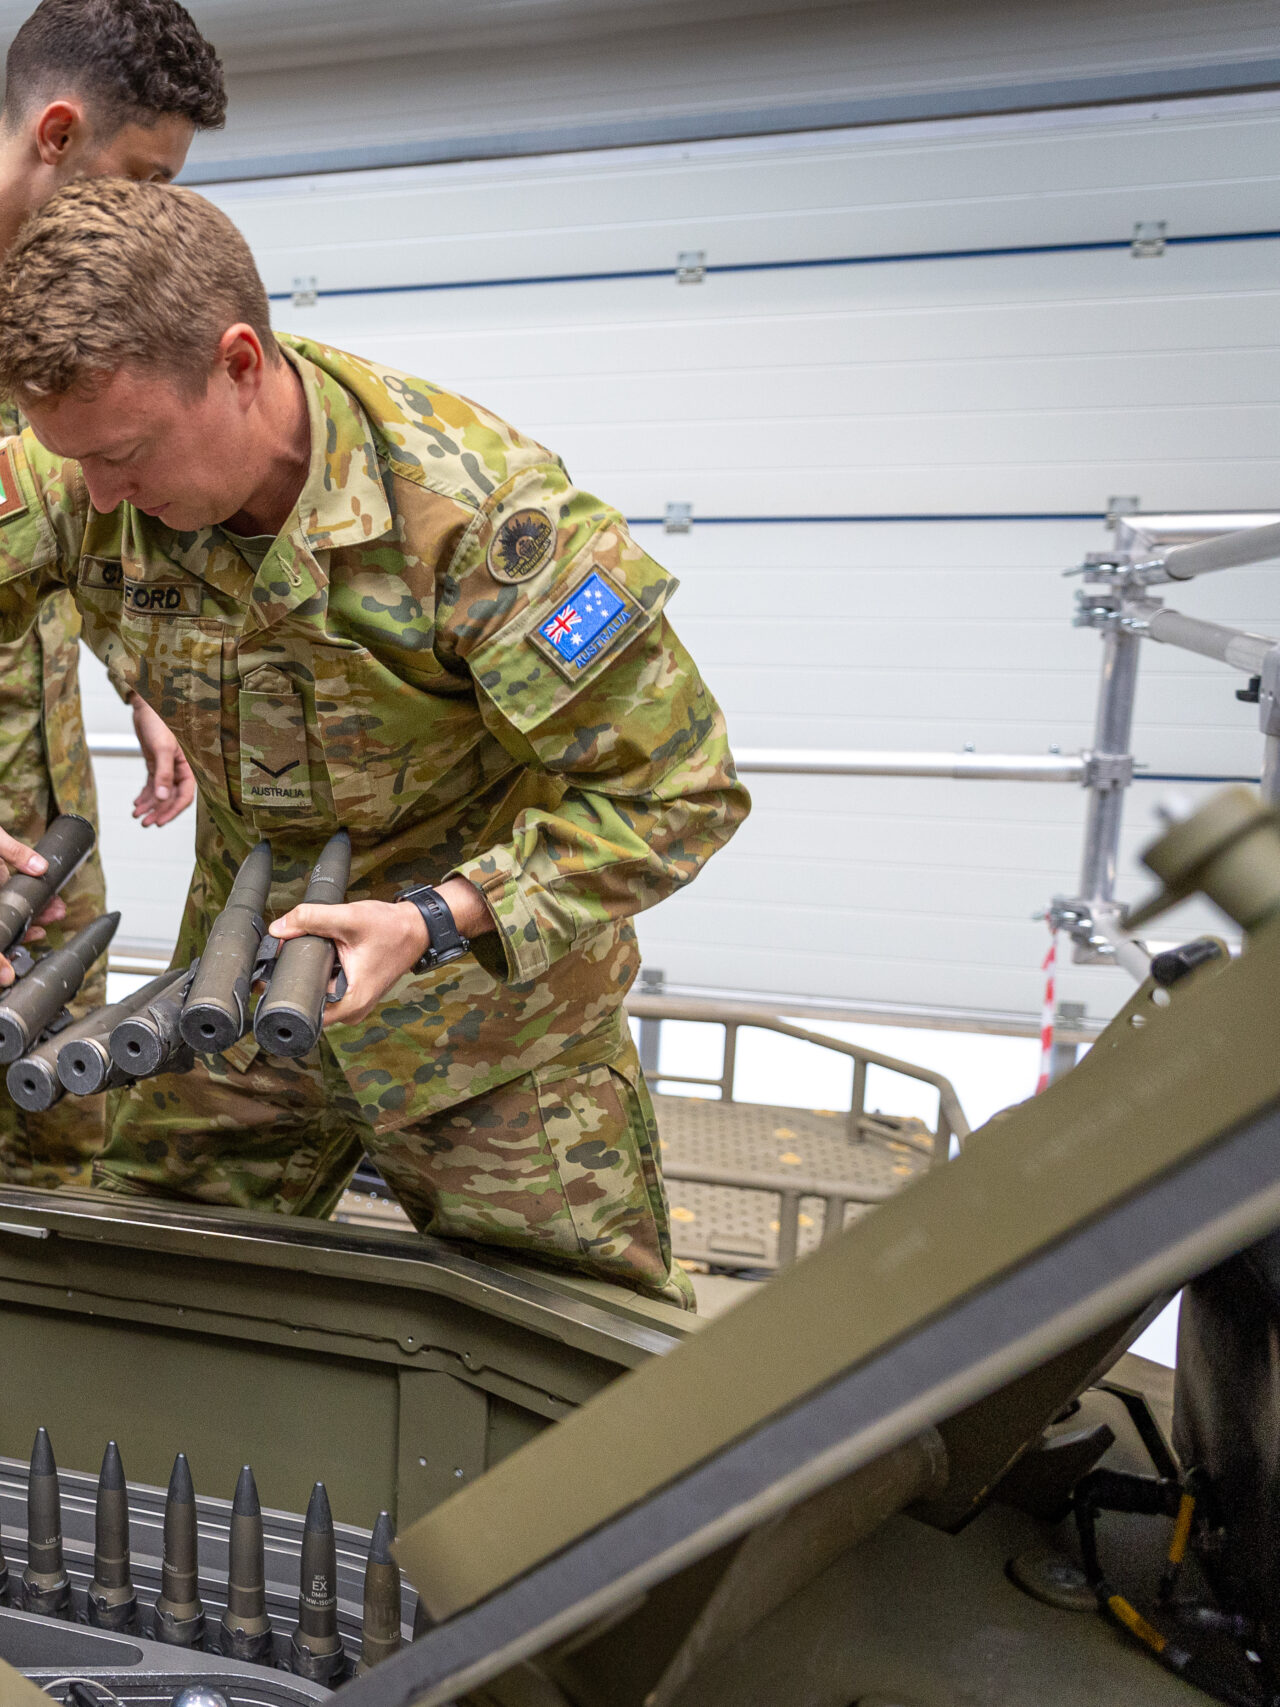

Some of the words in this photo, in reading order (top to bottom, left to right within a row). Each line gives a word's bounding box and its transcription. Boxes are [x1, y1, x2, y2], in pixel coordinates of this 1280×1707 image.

[574, 611, 632, 669] AUSTRALIA
[251, 786, 304, 798] AUSTRALIA
[312, 1581, 328, 1591] EX
